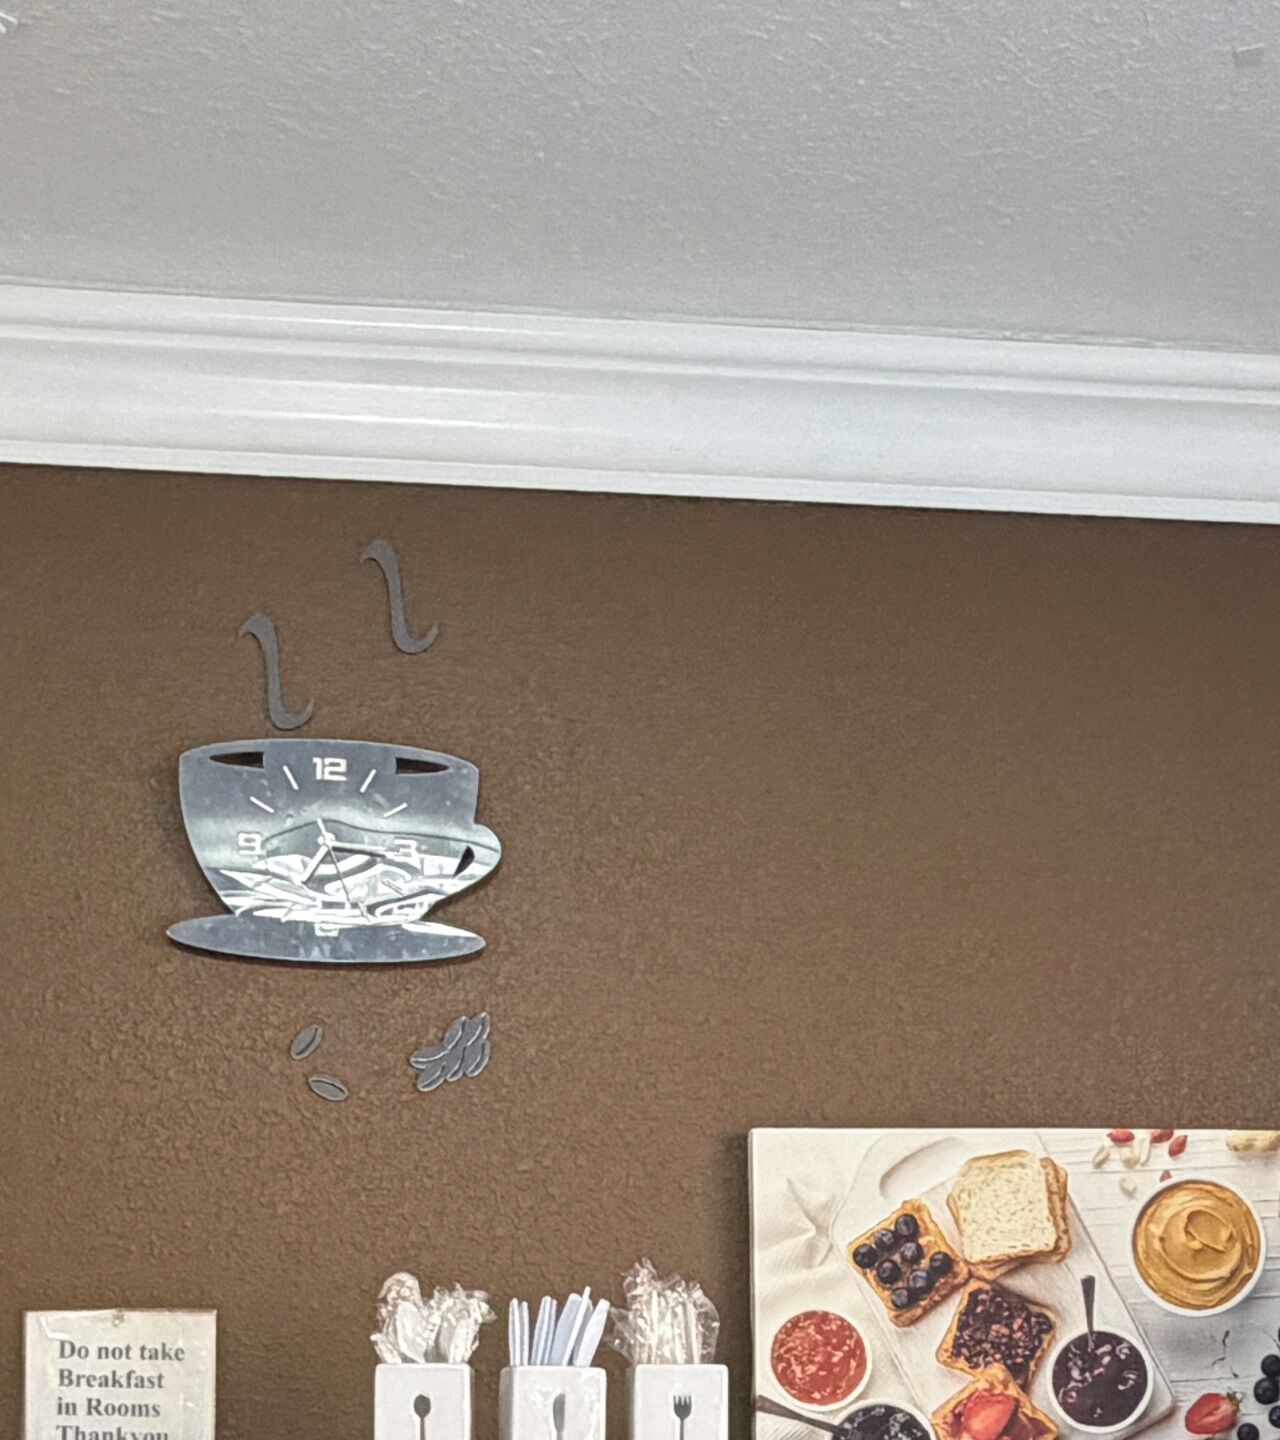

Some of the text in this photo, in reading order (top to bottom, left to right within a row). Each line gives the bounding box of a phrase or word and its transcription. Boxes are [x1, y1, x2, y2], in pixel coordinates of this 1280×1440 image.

[312, 757, 348, 781] 12
[58, 1339, 186, 1362] Do not take
[58, 1367, 166, 1390] Breakfast
[56, 1396, 162, 1418] in Rooms
